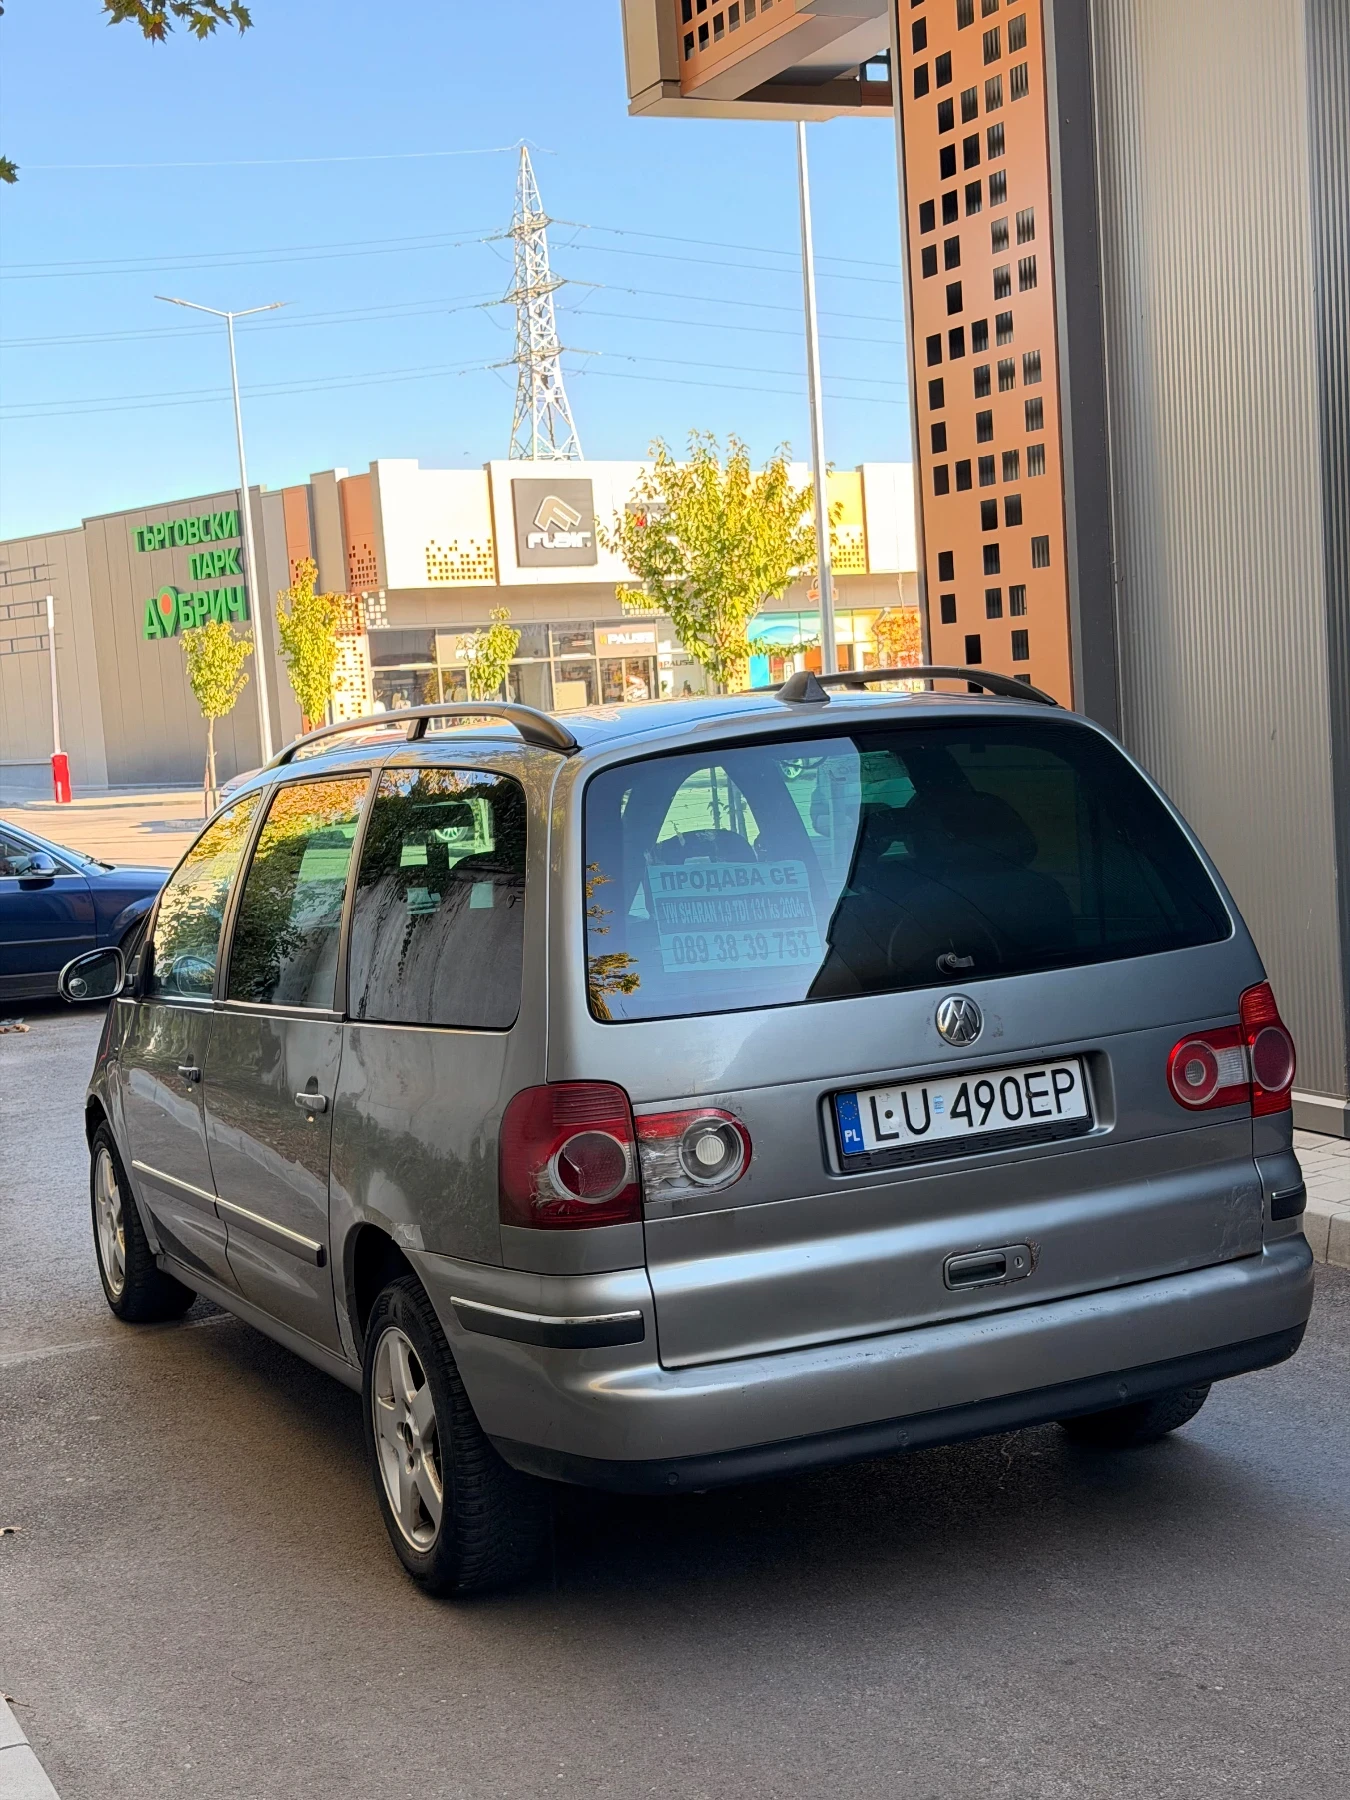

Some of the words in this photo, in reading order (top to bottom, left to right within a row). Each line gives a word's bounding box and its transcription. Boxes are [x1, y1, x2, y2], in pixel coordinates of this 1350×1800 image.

[130, 510, 241, 552] ТЪРГОВСКИ
[188, 547, 243, 580] ПАРК
[143, 586, 248, 640] ДОБРИЧ
[607, 631, 655, 645] PAUSE
[660, 868, 765, 892] ПРОДАВА
[769, 866, 798, 886] СЕ
[662, 902, 678, 924] VW
[678, 901, 718, 924] SHARAN
[732, 898, 750, 922] TDI
[750, 897, 767, 921] 131
[672, 934, 709, 965] 089
[714, 933, 739, 963] 38
[744, 932, 769, 961] 39
[772, 930, 811, 959] 753
[869, 1088, 931, 1142] LU
[949, 1067, 1075, 1128] 490EP
[845, 1129, 861, 1143] PL
